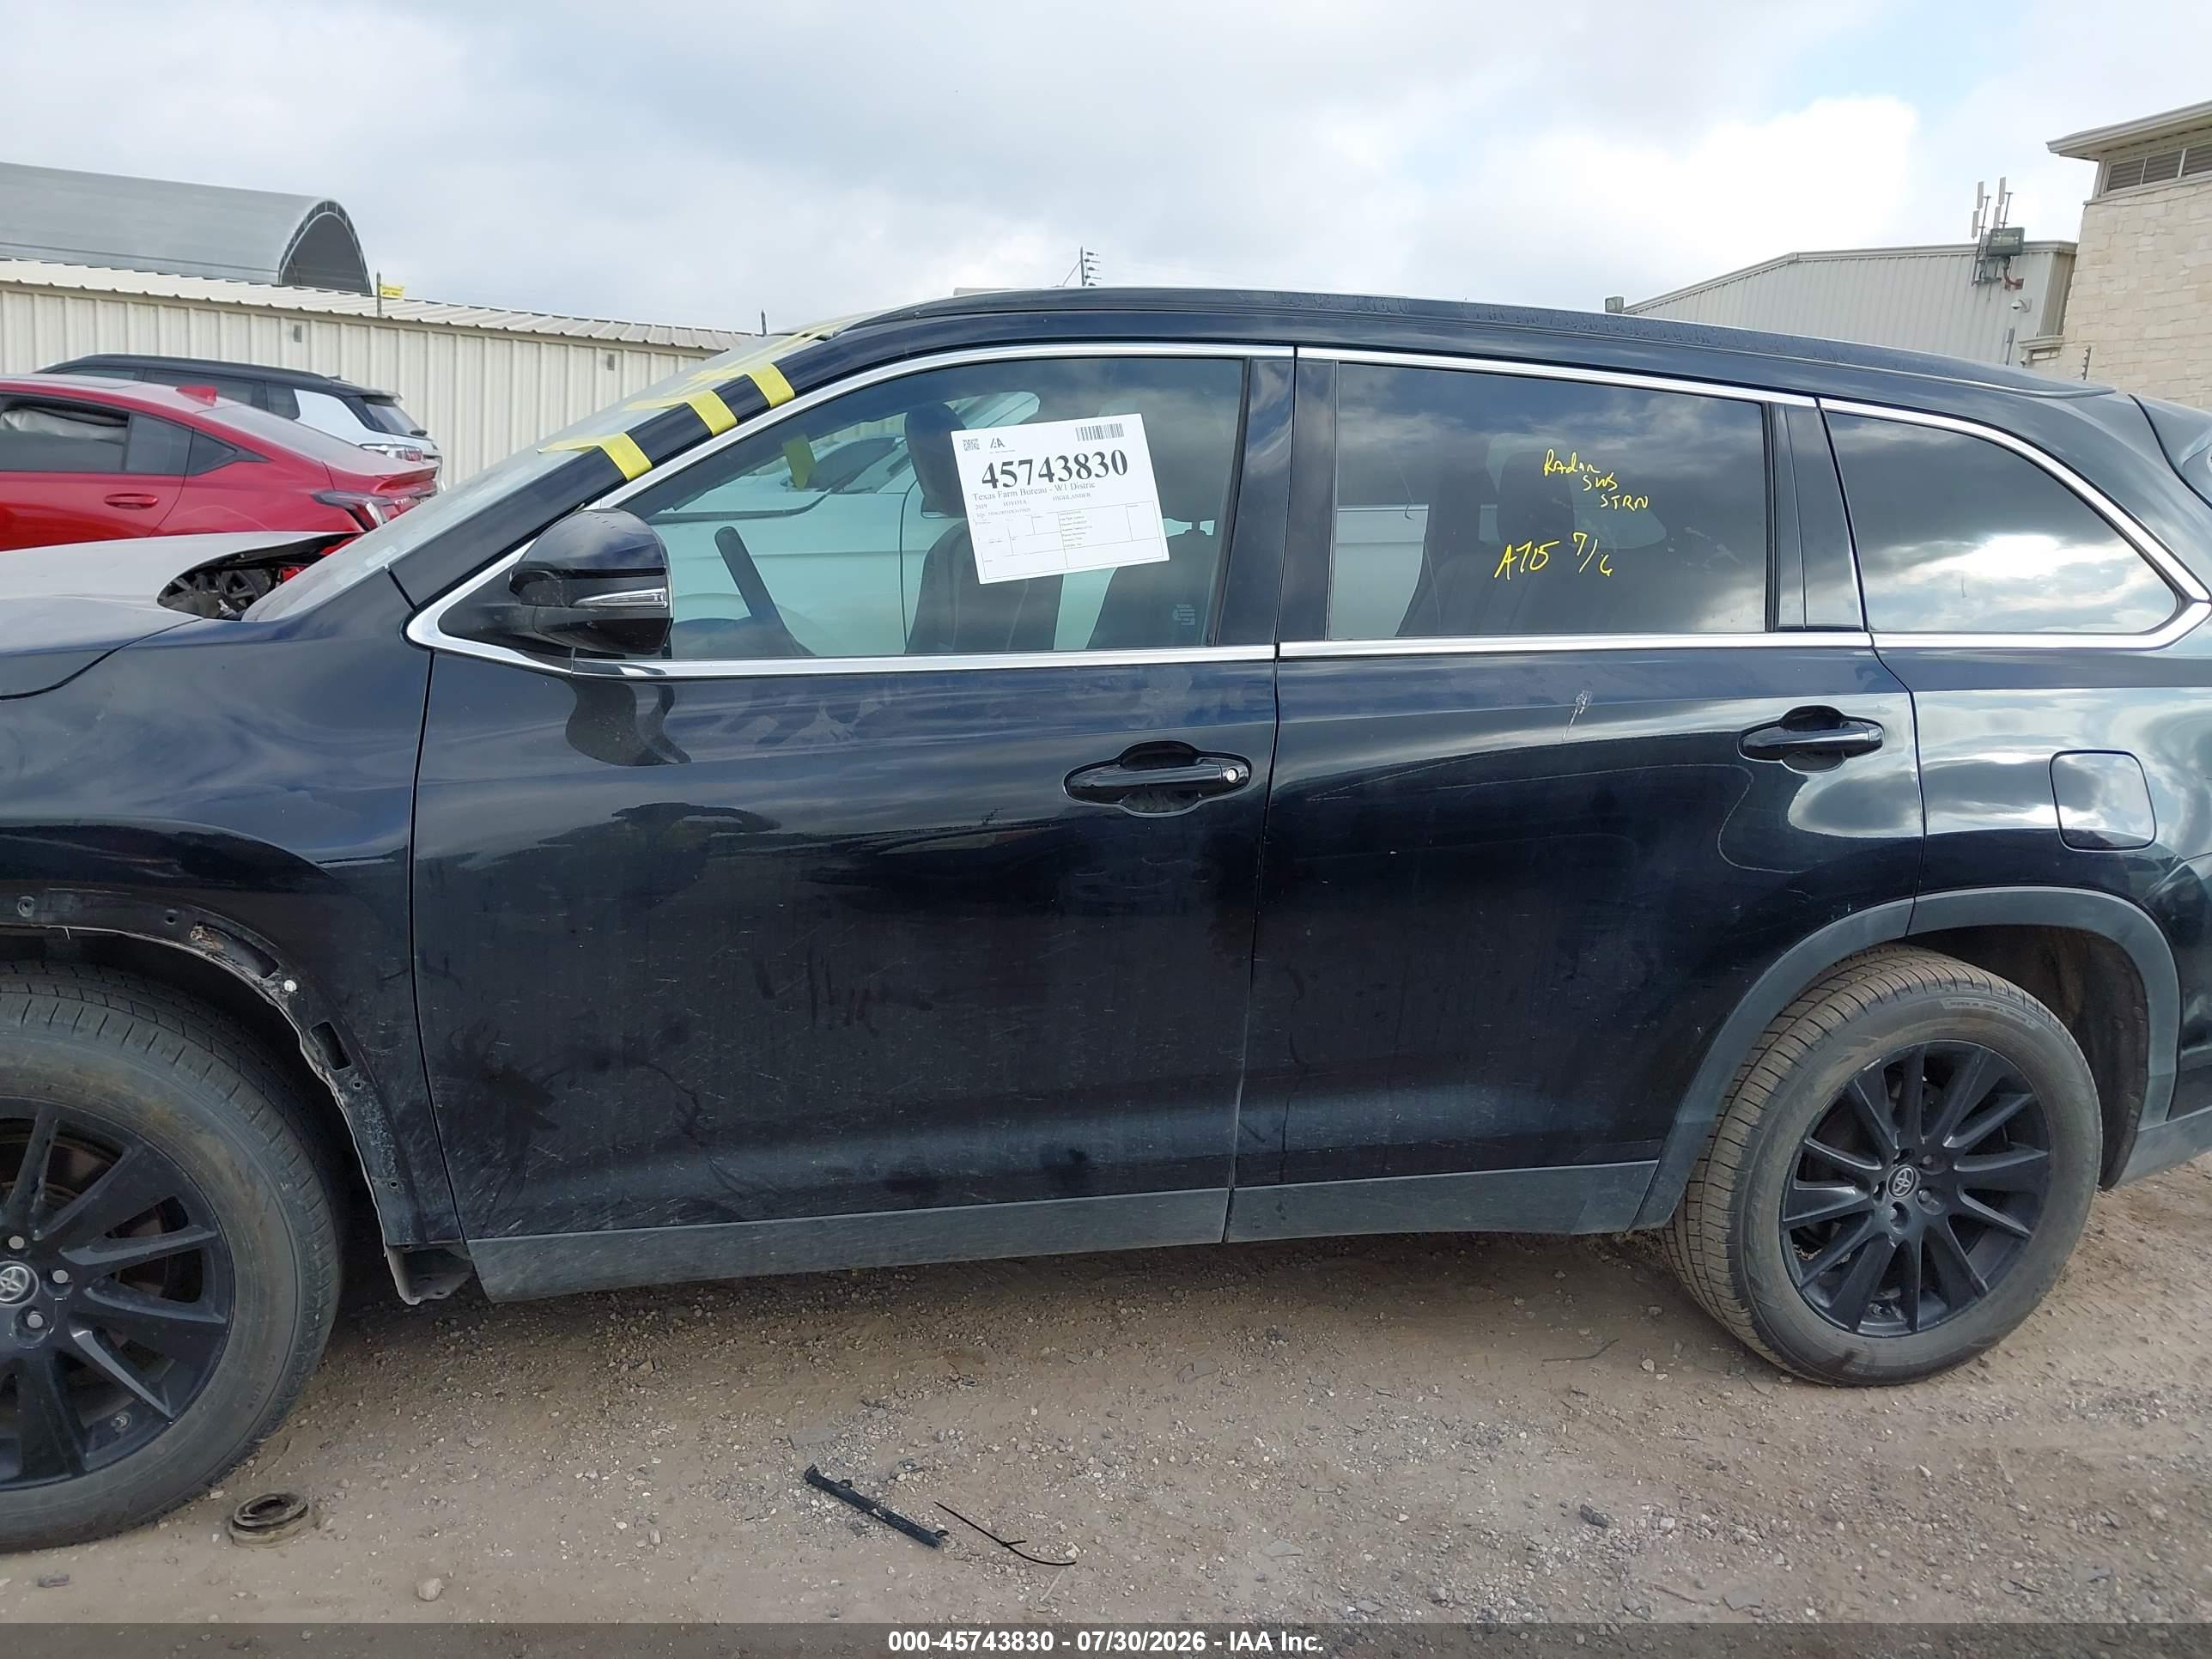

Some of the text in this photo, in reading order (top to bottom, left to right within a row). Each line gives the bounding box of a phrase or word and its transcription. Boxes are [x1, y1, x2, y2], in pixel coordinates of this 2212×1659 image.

[981, 449, 1128, 489] 45743830
[972, 492, 996, 501] Texas
[998, 489, 1018, 499] Farm
[1020, 486, 1048, 496] Bureau
[1070, 480, 1096, 491] Distric
